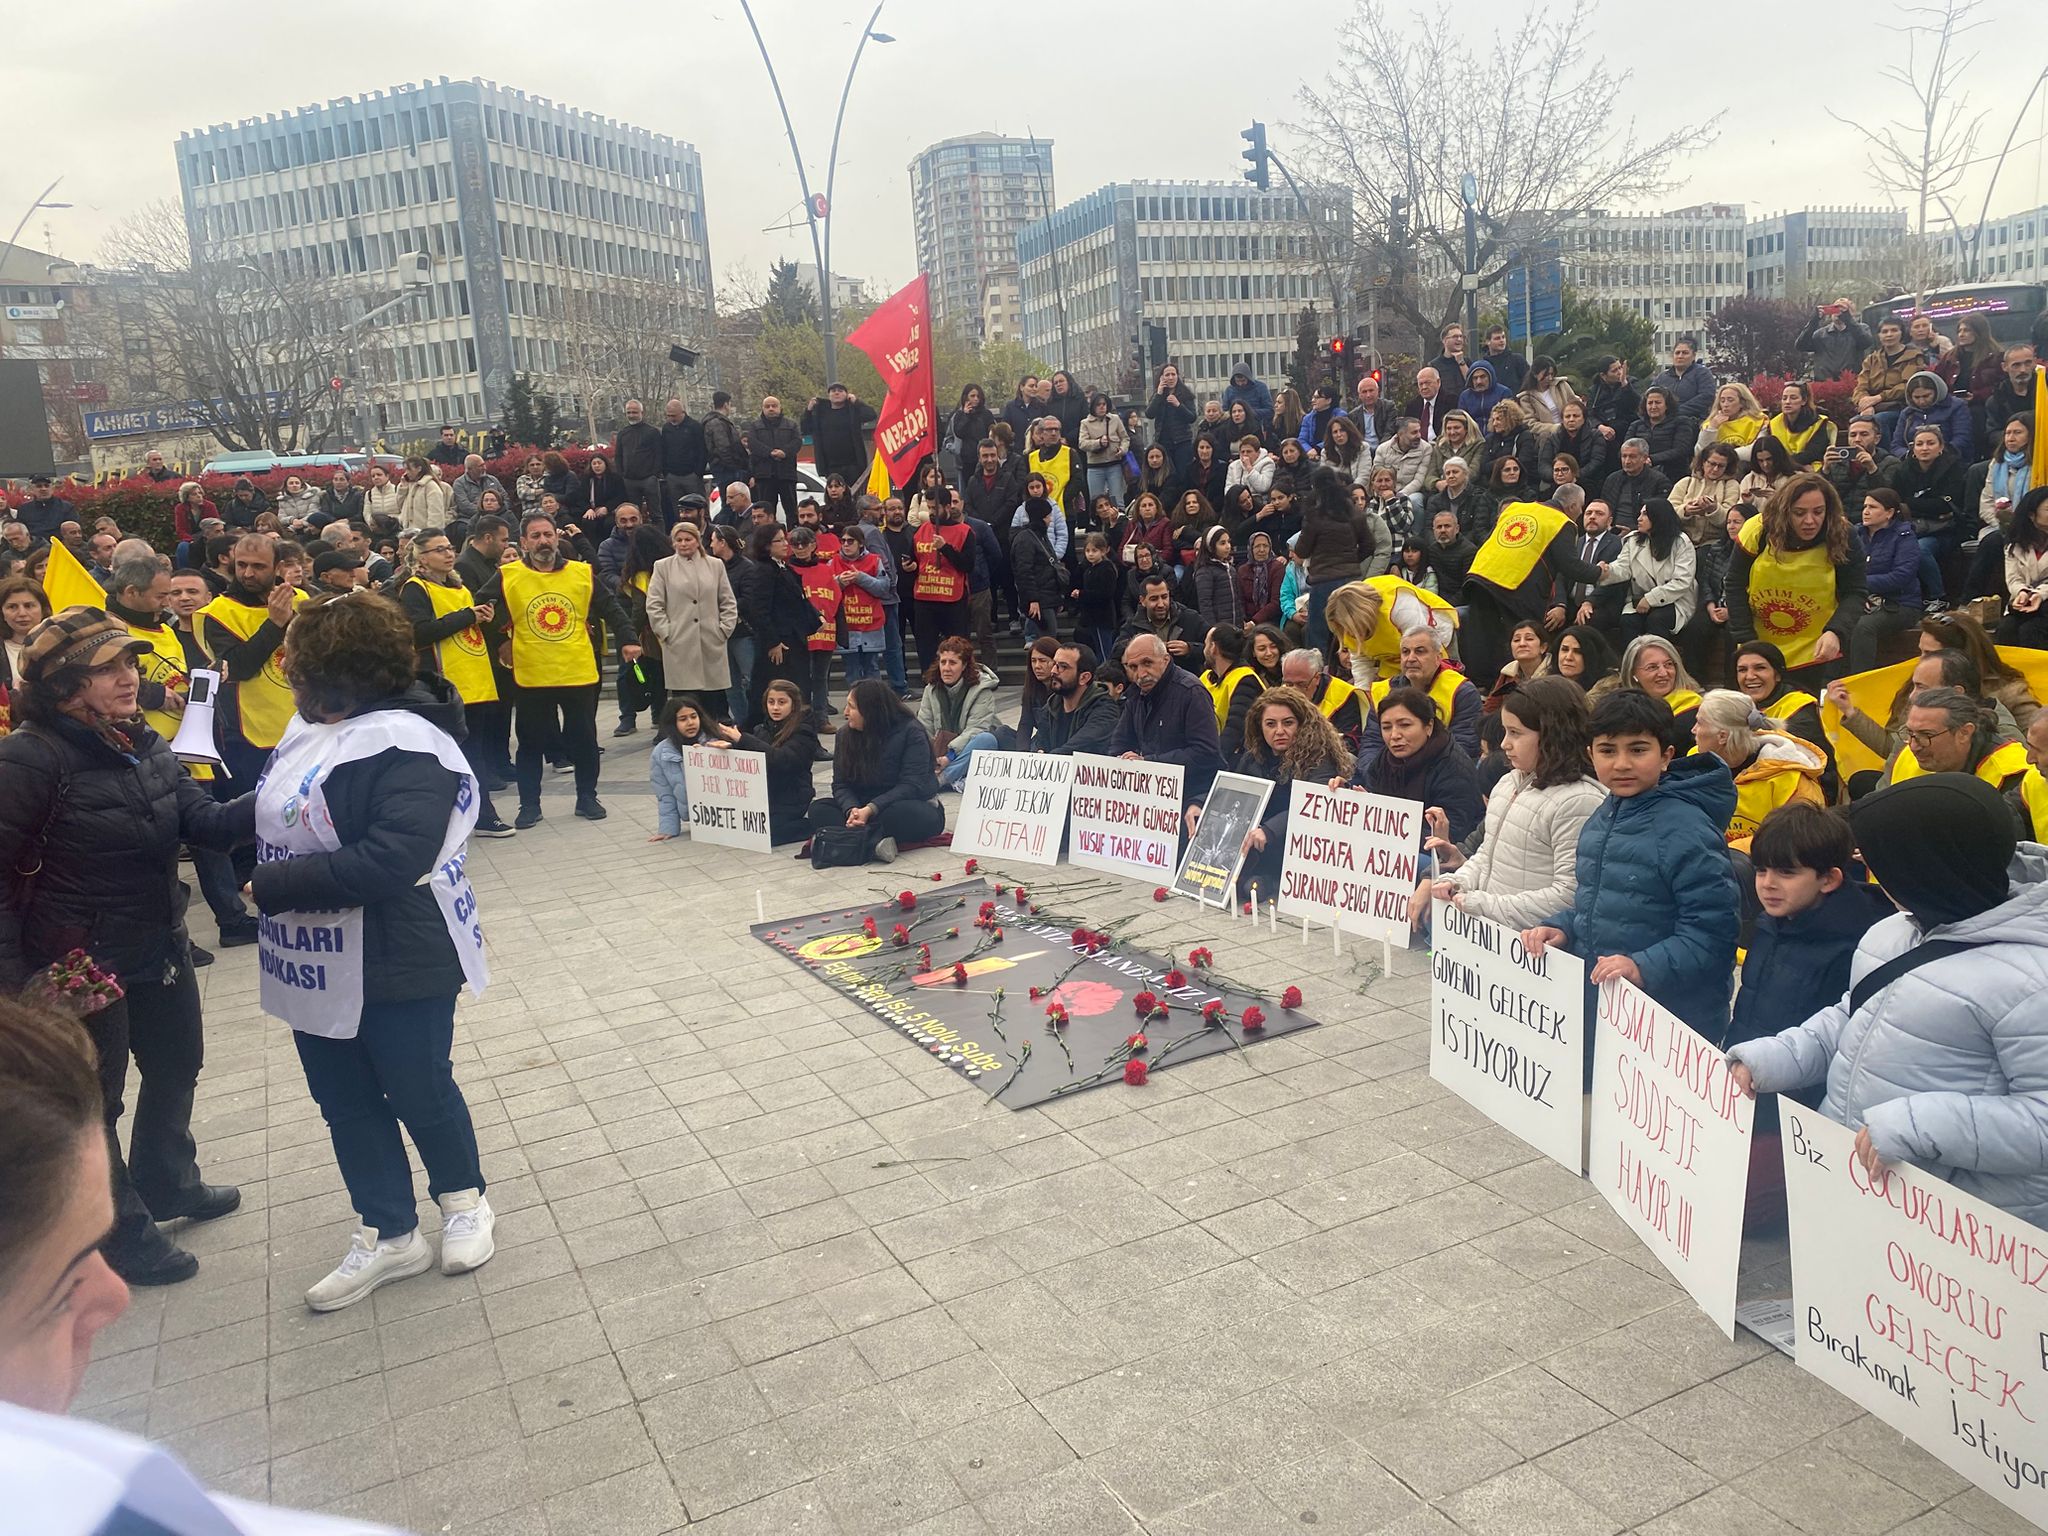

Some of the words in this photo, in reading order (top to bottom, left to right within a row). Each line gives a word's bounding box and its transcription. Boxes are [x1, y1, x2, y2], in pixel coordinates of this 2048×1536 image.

[92, 411, 151, 433] AHMET
[976, 785, 1010, 811] YUSUF
[1014, 786, 1054, 815] TEKİN
[1074, 765, 1109, 789] ADNAN
[1110, 768, 1153, 795] GÖKTÜRK
[1154, 775, 1179, 801] YEŞİL
[692, 802, 737, 829] ŞİDDETE
[742, 810, 767, 834] HAYIR
[1072, 796, 1102, 819] KEREM
[1105, 799, 1140, 827] ERDEM
[1143, 805, 1180, 836] GÜNGÖR
[1299, 792, 1360, 827] ZEYNEP
[1363, 804, 1410, 840] KILINÇ
[1079, 830, 1106, 855] YUSUF
[1110, 835, 1142, 861] TARIK
[1289, 832, 1355, 872] MUSTAFA
[1364, 847, 1416, 883] ASLAN
[1281, 870, 1339, 908] ŞURANUR
[1340, 882, 1372, 915] SEVGİ
[1373, 889, 1412, 923] KAZICI
[860, 983, 894, 1001] Sen
[906, 1012, 931, 1021] 5
[1432, 947, 1481, 1000] GÜVENLİ
[1489, 983, 1567, 1045] GELECEK
[916, 1018, 962, 1044] Nolu
[1441, 998, 1554, 1109] İSTİYORUZ
[1599, 980, 1656, 1062] SUSMA
[1663, 1021, 1745, 1134] HAYKIR
[1614, 1053, 1704, 1176] ŞİDDETE
[1790, 1115, 1832, 1173] Biz
[1617, 1140, 1672, 1242] HAYIR
[1887, 1240, 2008, 1341] ONURLU
[1808, 1305, 1921, 1408] Bırakmak
[1865, 1293, 2036, 1424] GELECEK
